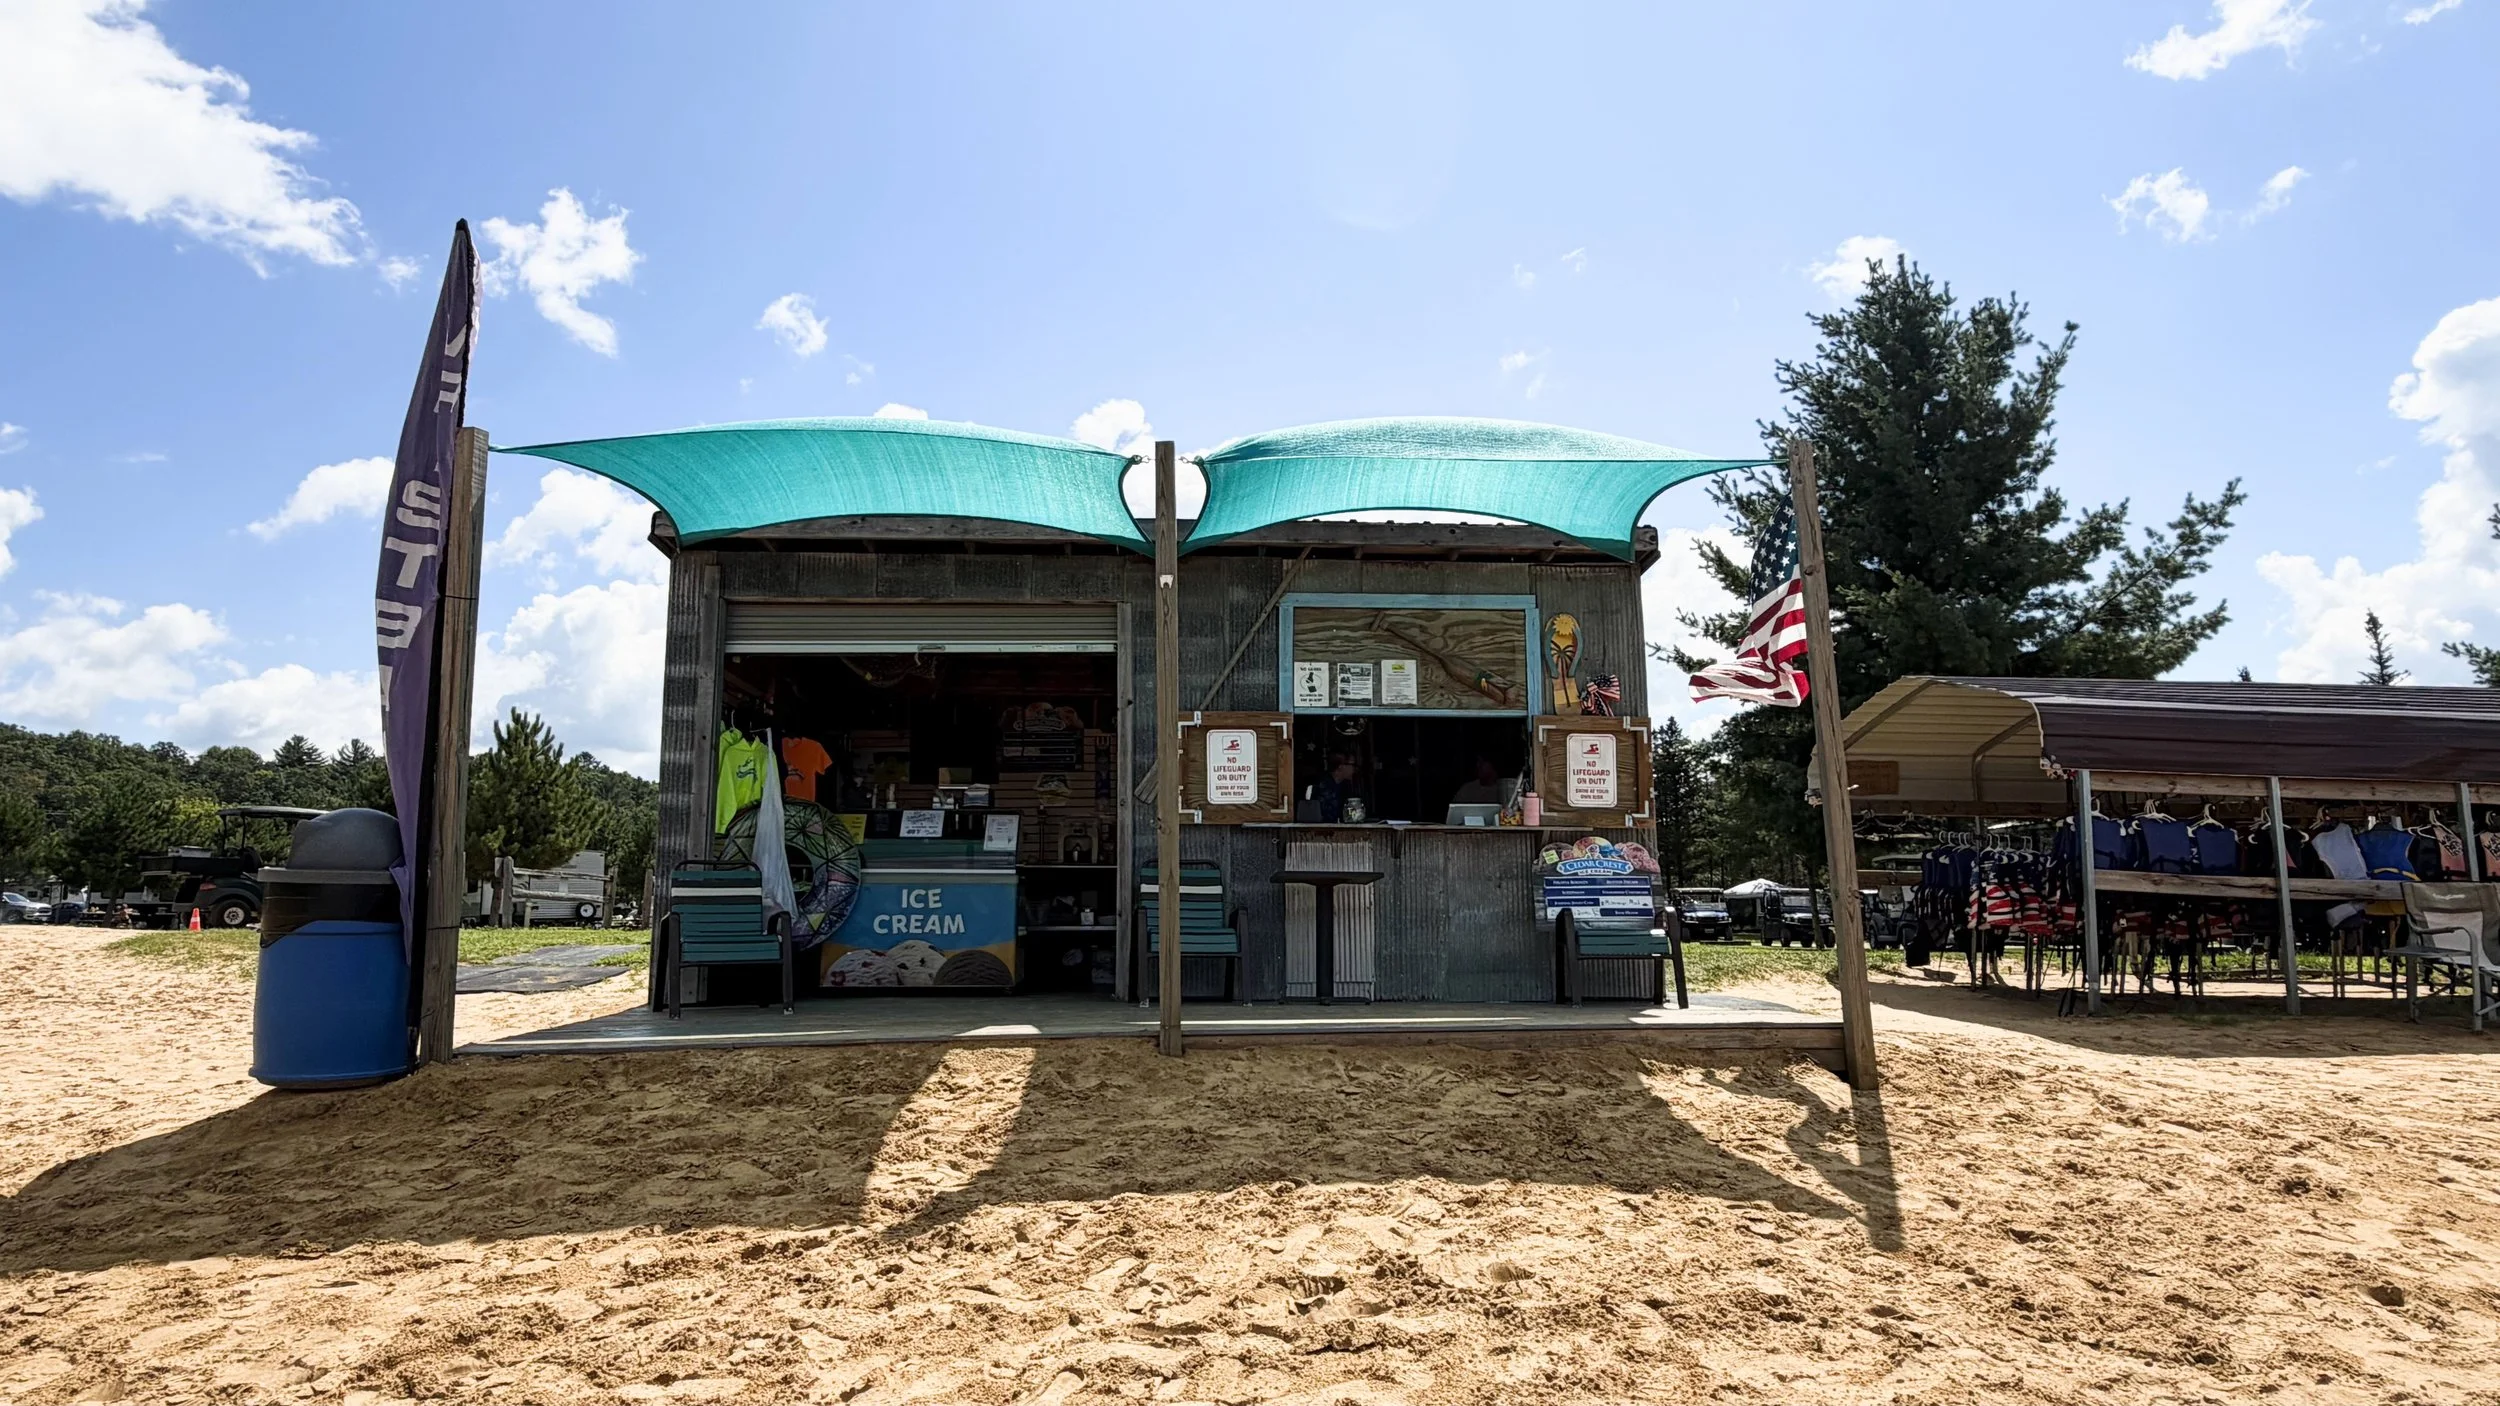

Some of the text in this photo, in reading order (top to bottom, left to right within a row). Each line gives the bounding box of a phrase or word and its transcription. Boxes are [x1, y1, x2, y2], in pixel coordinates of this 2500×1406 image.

[1566, 860, 1624, 870] CEDAR CREST
[902, 888, 942, 909] ICE
[873, 914, 966, 935] CREAM
